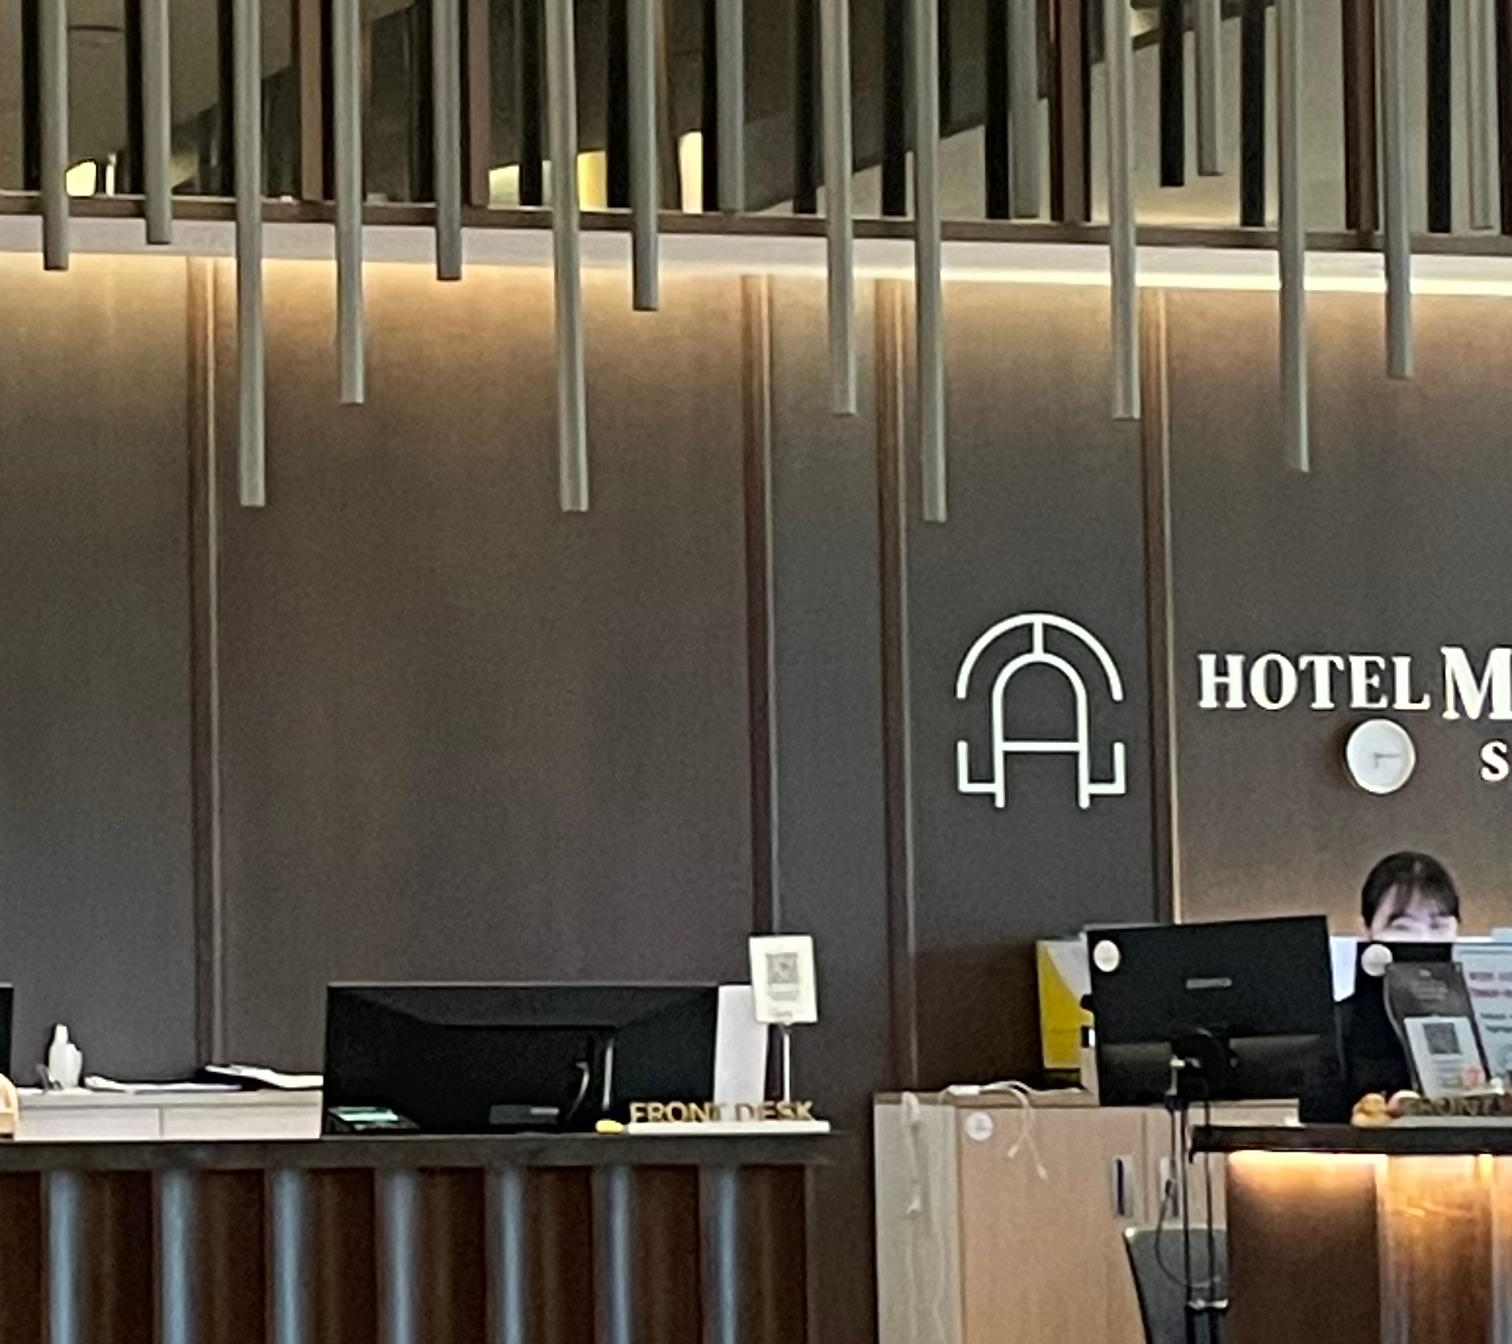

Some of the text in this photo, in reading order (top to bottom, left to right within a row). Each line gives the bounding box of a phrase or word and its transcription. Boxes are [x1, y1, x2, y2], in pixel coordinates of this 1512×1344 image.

[1197, 652, 1431, 711] HOTEL
[1480, 739, 1510, 782] S
[629, 1100, 813, 1123] FRONT DESK
